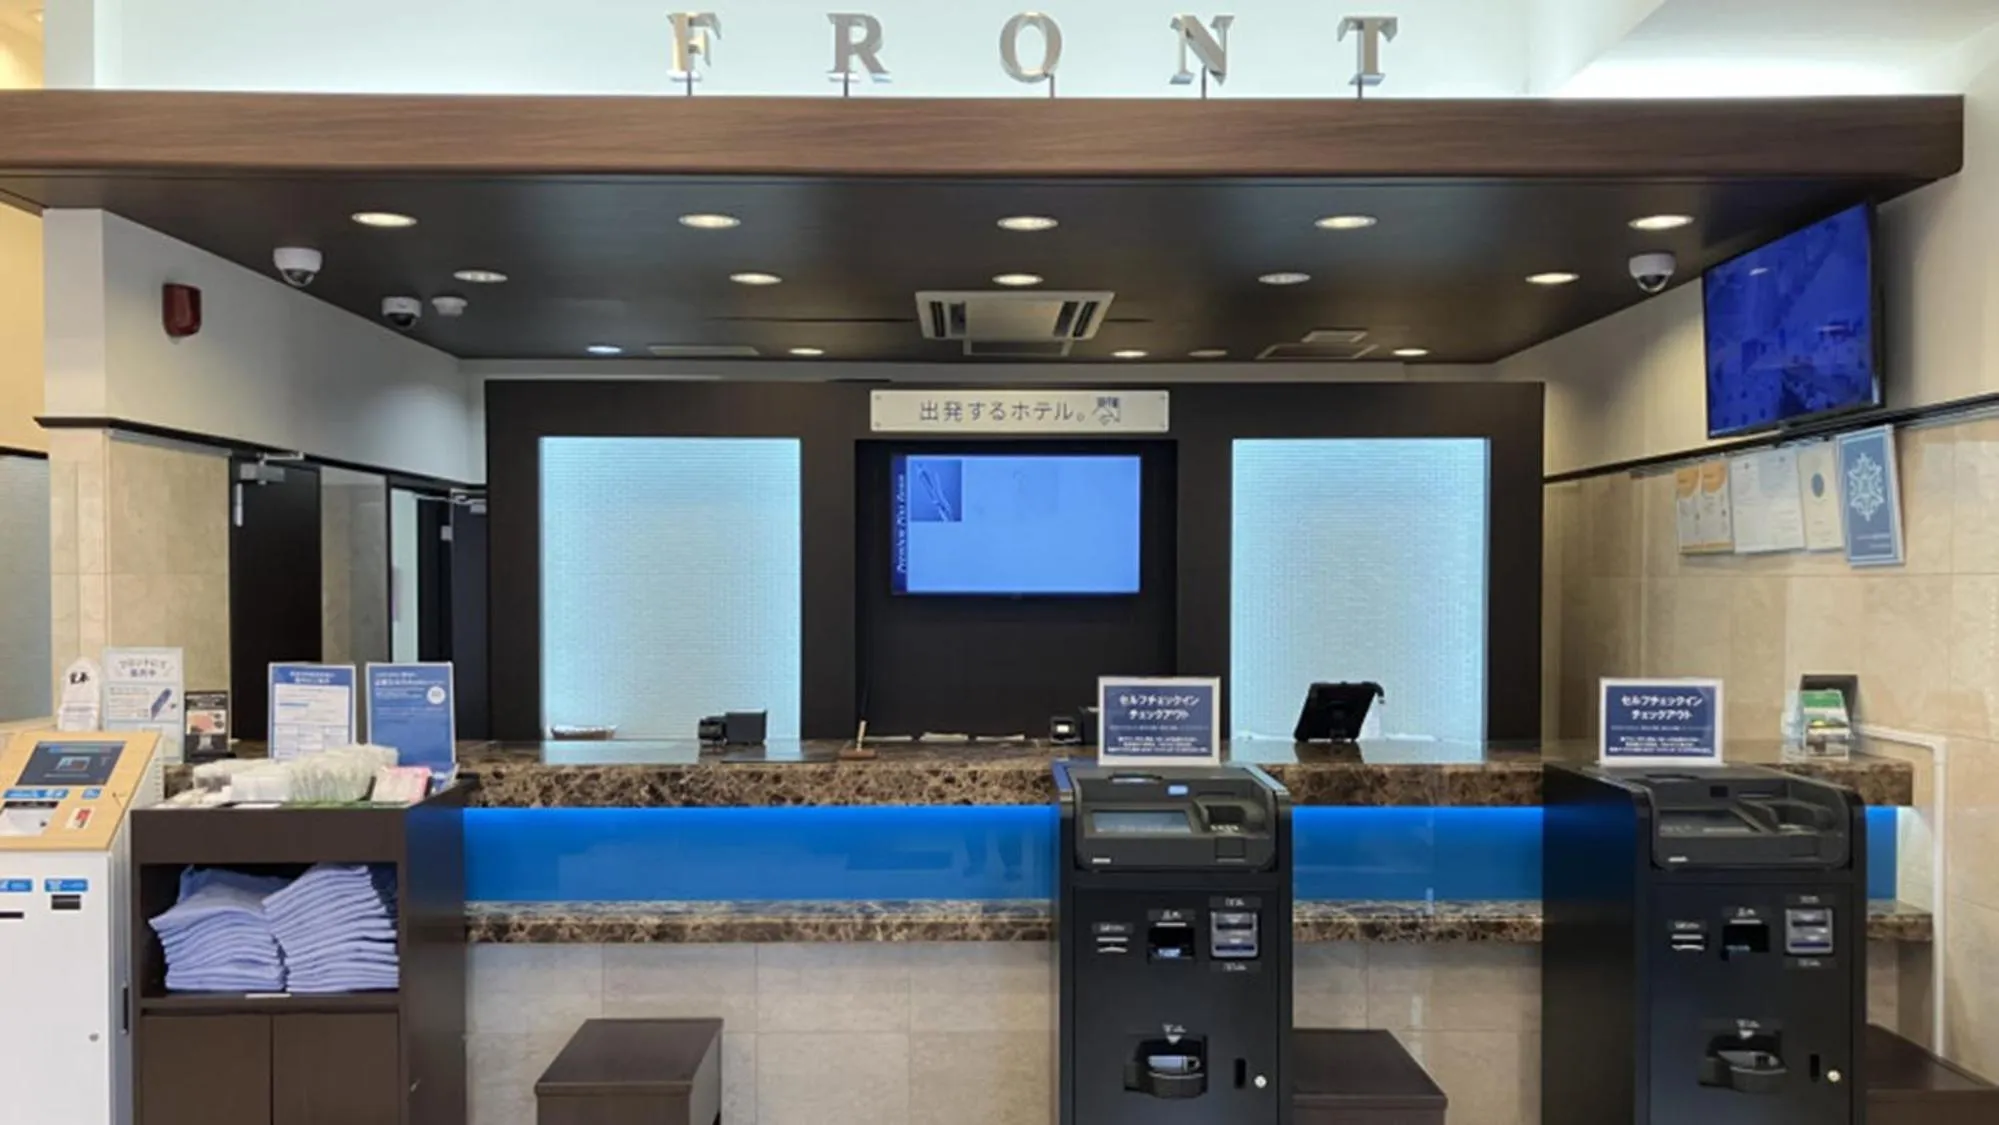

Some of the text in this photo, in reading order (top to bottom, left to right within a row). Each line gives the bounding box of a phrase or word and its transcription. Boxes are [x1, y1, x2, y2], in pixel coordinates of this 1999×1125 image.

[667, 11, 1399, 85] FRONT
[920, 400, 1085, 422] 出発するホテル。
[1119, 694, 1200, 707] セルフチェックイン
[1621, 694, 1703, 707] セルフチェックイン
[1129, 709, 1190, 720] チェックアウト
[1631, 709, 1692, 720] チェックアウト
